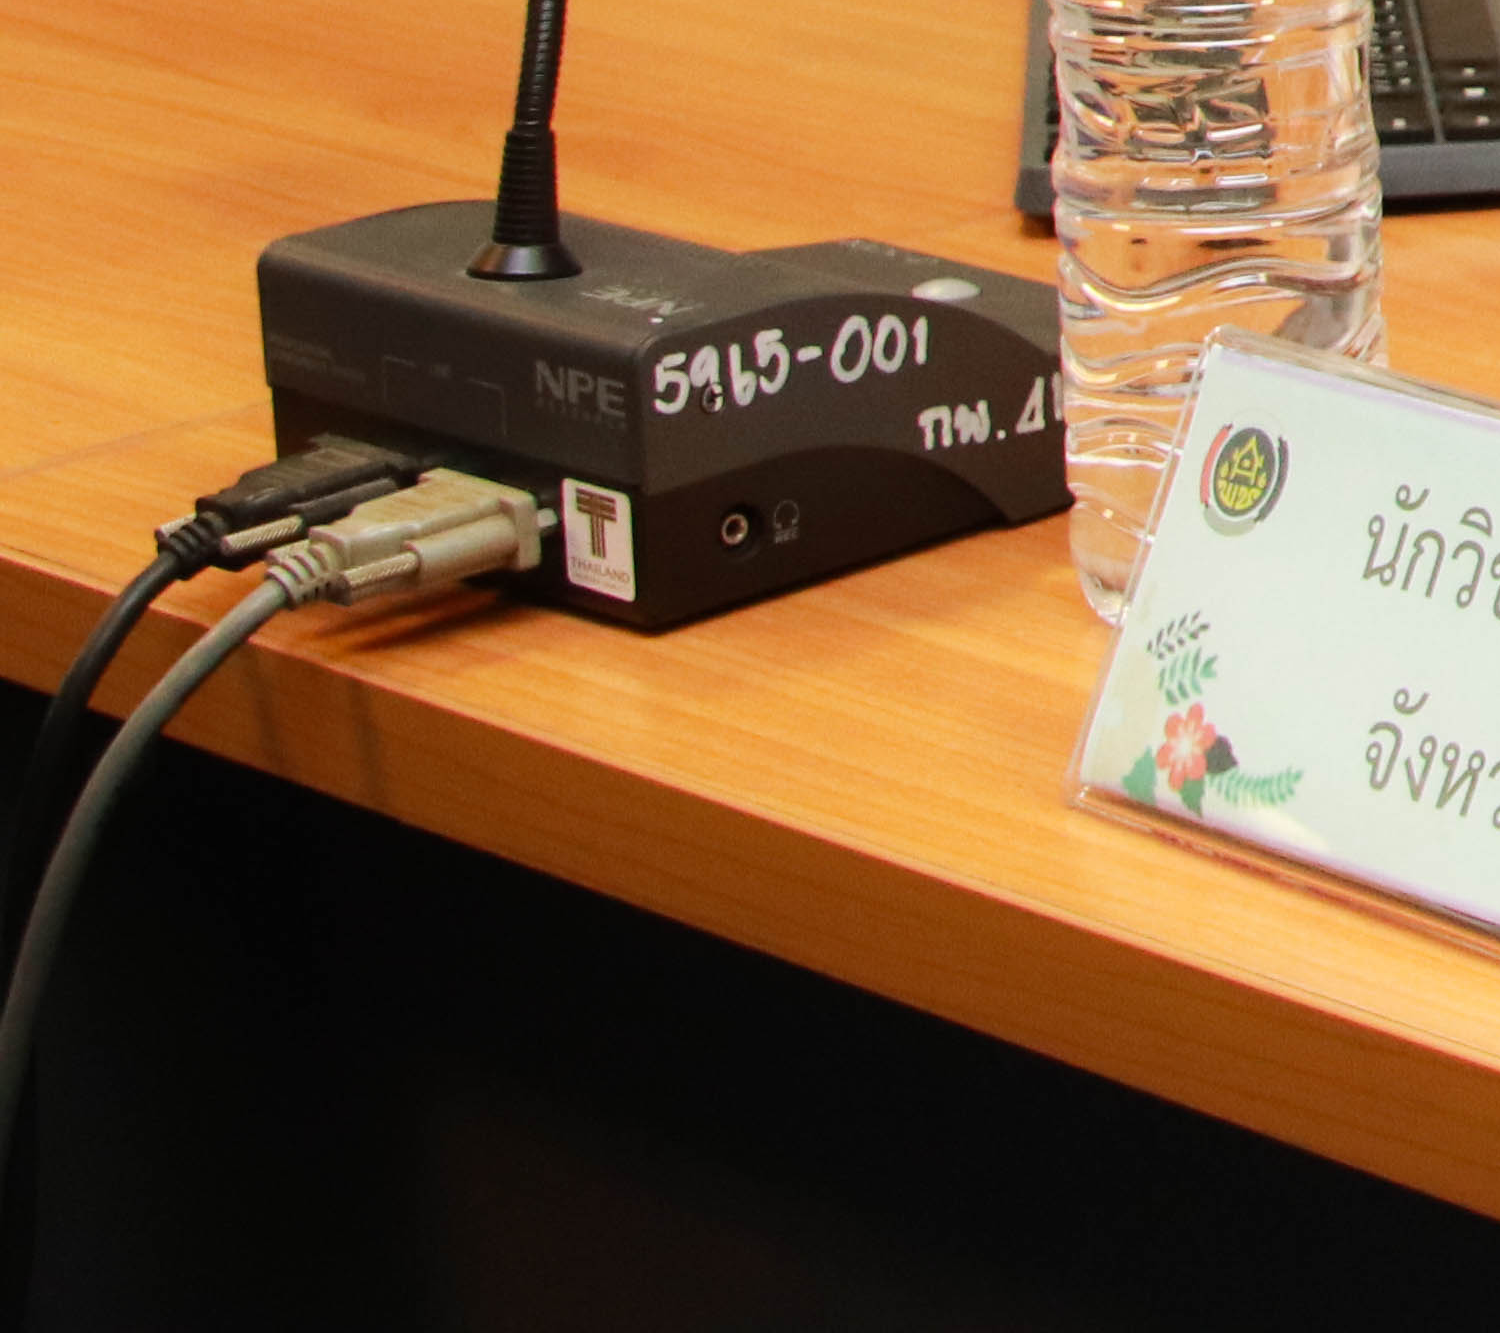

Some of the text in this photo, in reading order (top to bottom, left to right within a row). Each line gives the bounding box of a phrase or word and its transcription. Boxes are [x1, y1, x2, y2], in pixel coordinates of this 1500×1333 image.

[533, 359, 628, 419] NPE
[653, 314, 929, 415] 5965-001
[569, 555, 631, 585] THAILAND
